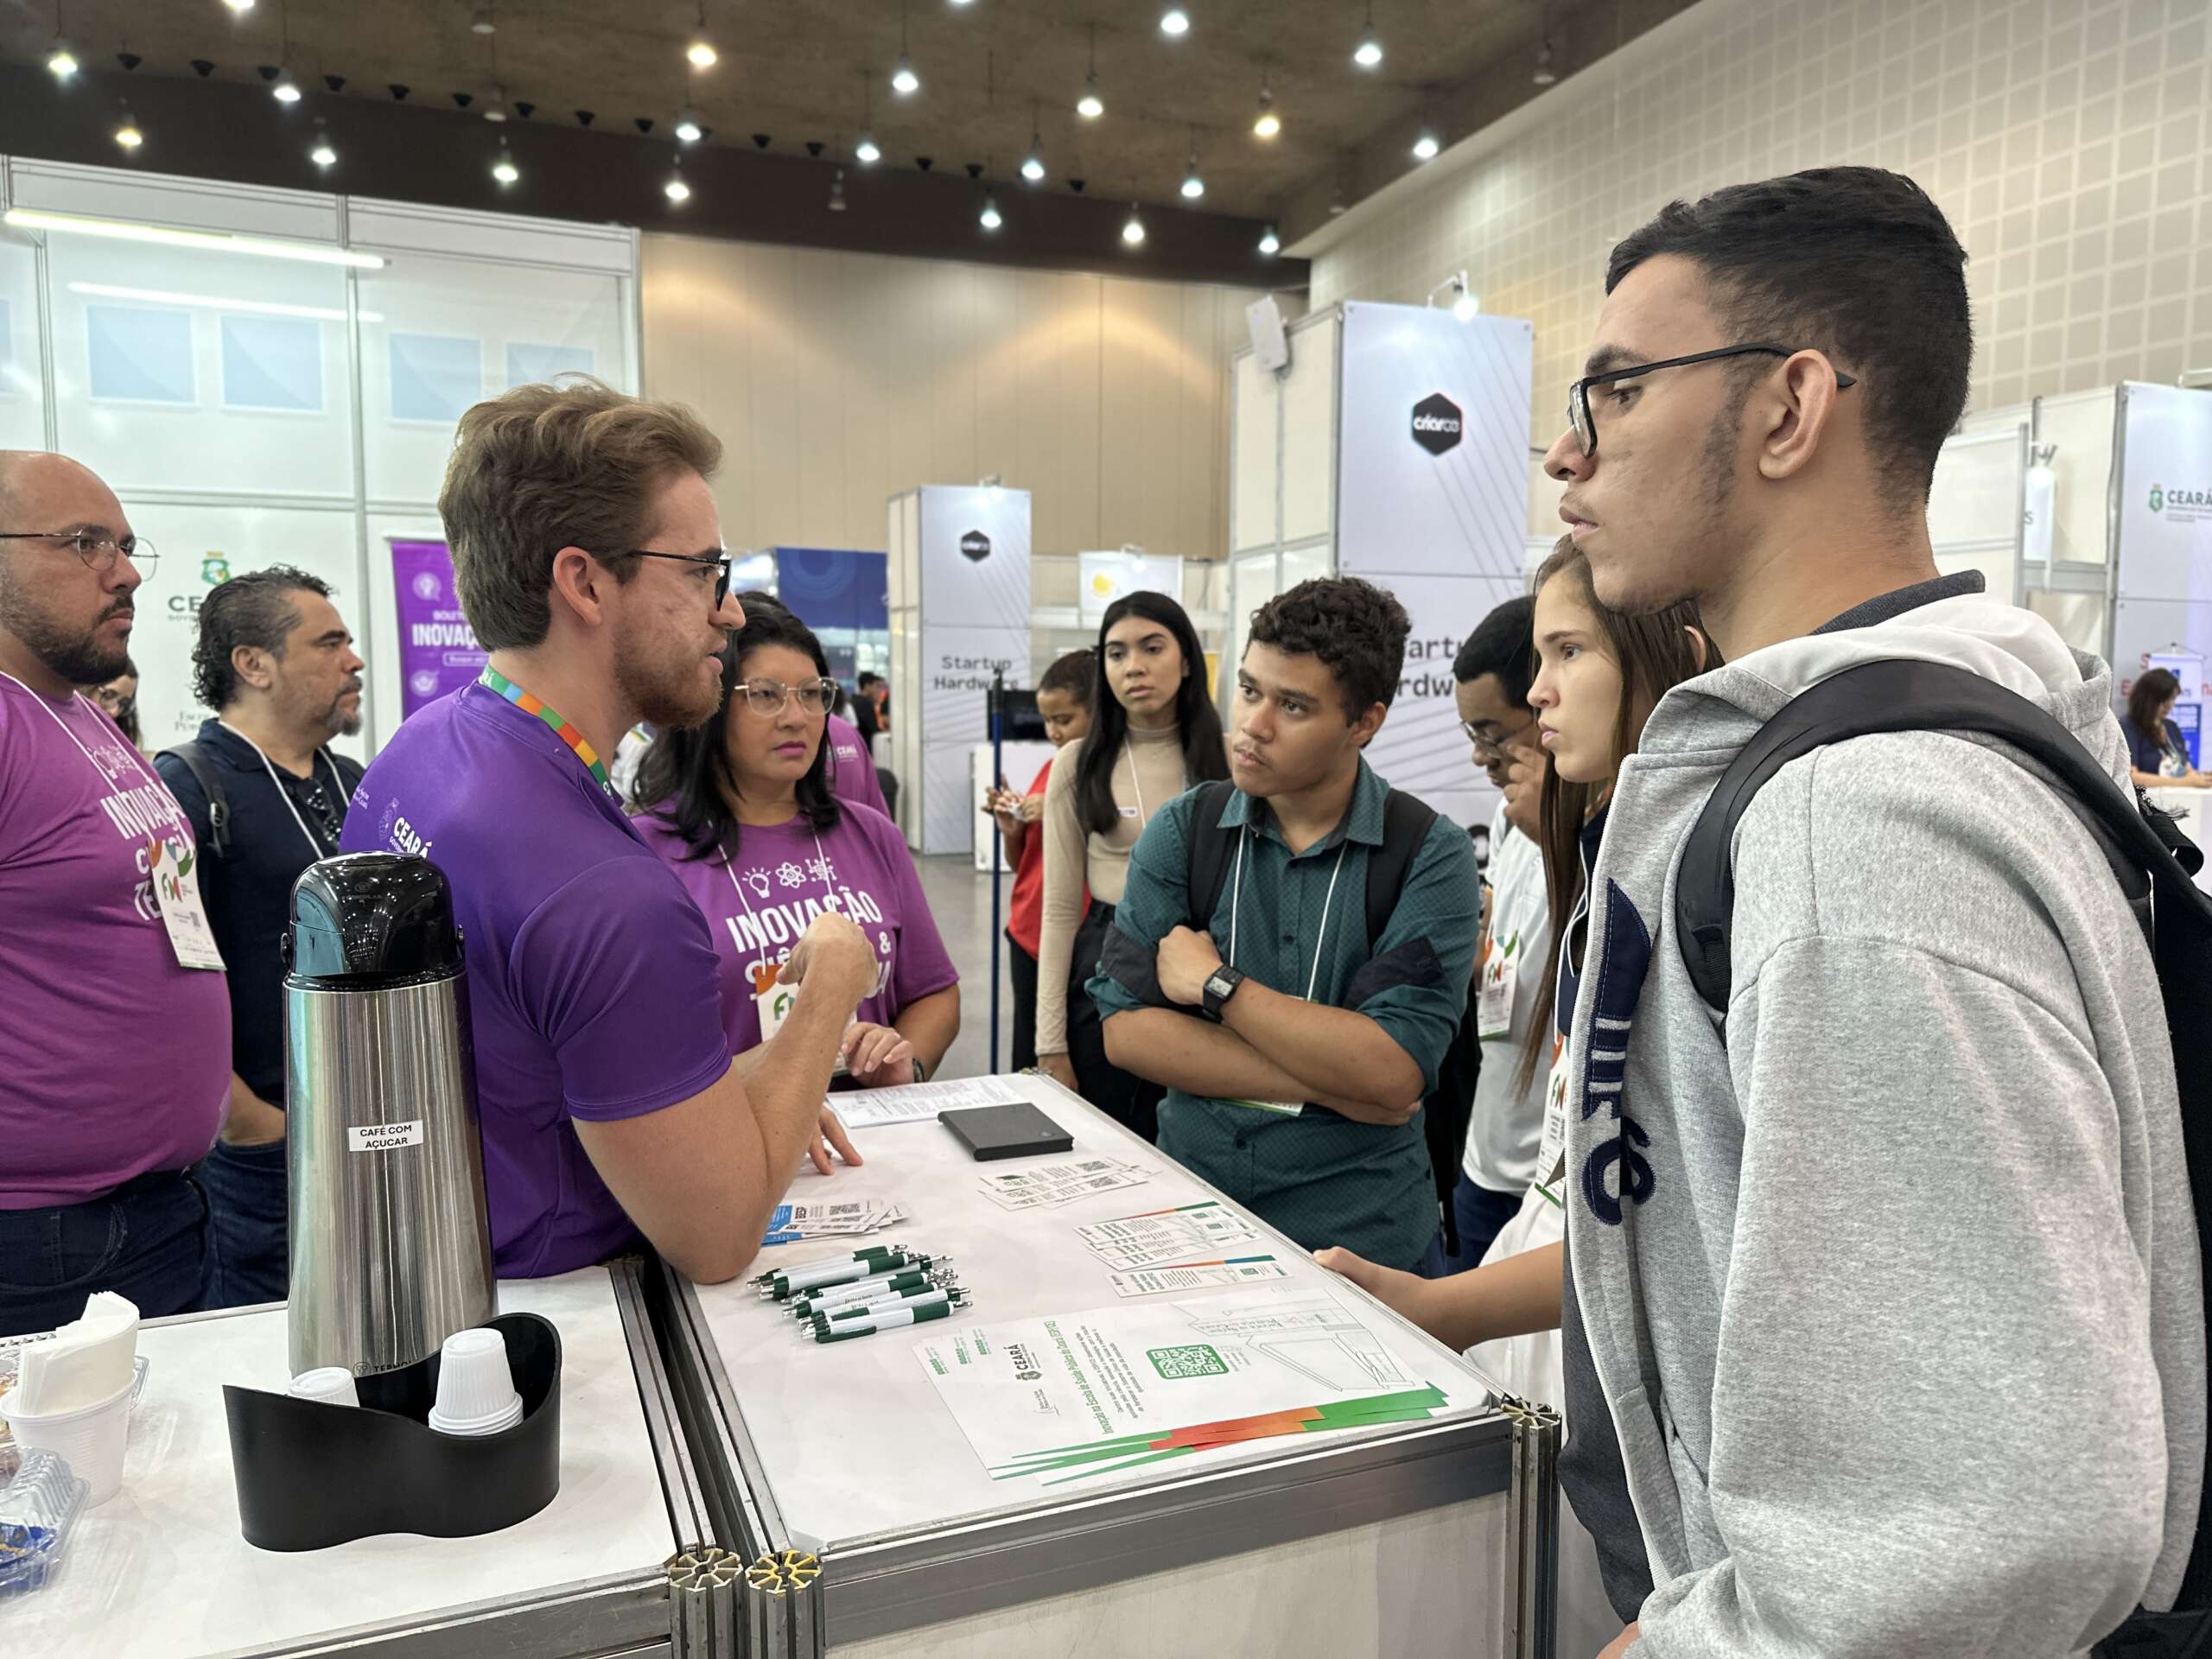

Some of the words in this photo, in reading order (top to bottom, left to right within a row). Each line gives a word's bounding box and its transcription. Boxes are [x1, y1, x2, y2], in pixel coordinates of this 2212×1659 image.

[168, 595, 202, 613] CE
[412, 623, 478, 650] INOVAÇ
[941, 656, 1012, 671] Startup
[934, 676, 1020, 690] Hardwre
[878, 931, 891, 955] &
[388, 1124, 412, 1135] COM
[1003, 1344, 1028, 1370] CEARÁ
[1065, 1355, 1079, 1370] Pública
[1071, 1370, 1087, 1384] Saúde
[1082, 1389, 1099, 1407] Escola
